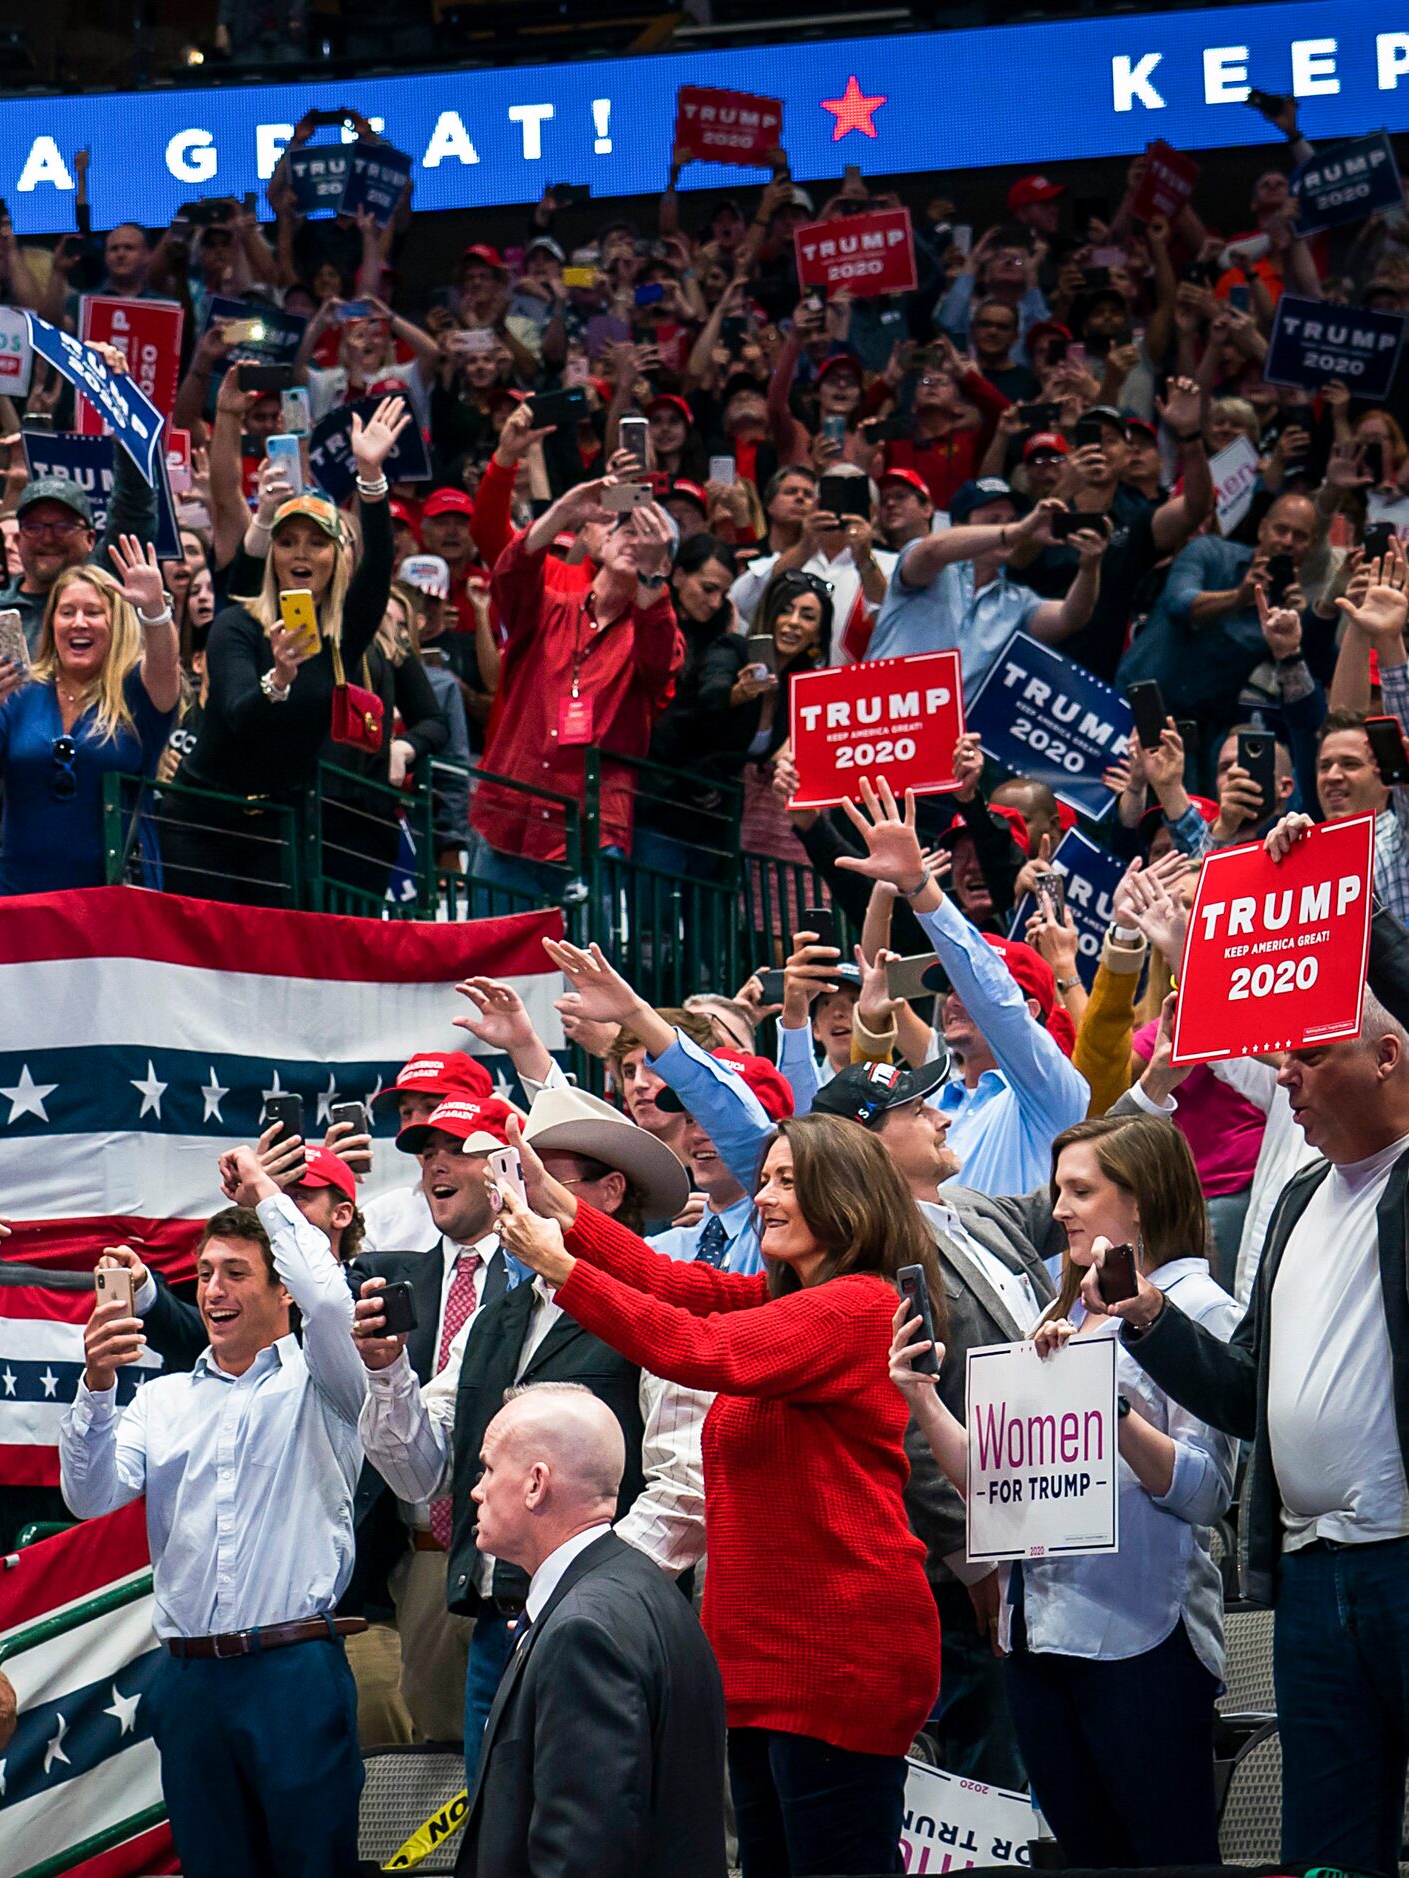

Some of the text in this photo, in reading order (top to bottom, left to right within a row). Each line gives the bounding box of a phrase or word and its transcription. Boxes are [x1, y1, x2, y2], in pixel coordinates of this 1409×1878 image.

[1112, 32, 1409, 112] KEEP
[683, 105, 778, 128] TRUMP
[702, 131, 755, 149] 2020
[293, 158, 346, 178] TRU
[354, 158, 407, 187] TRUM
[316, 182, 343, 196] 20
[1317, 183, 1370, 210] 2020
[801, 229, 906, 262] TRUMP
[827, 260, 885, 282] 2020
[1283, 316, 1397, 351] TRUMP
[139, 344, 159, 398] 020
[1302, 351, 1365, 376] 2020
[33, 461, 115, 492] TRUM
[799, 687, 951, 732] TRUMP
[826, 721, 924, 743] KEEP AMERICA GREAT!
[1037, 715, 1073, 741] AMERICA
[835, 738, 916, 770] 2020
[1009, 718, 1086, 774] 2020
[1051, 859, 1115, 922] TRU
[1201, 874, 1361, 941] TRUMP
[1224, 930, 1330, 960] KEEP AMERICA GREAT!
[1228, 956, 1319, 1001] 2020
[975, 1401, 1103, 1471] Women
[989, 1472, 1091, 1504] FOR TRUMP
[959, 1779, 990, 1795] 2020
[428, 1796, 470, 1845] NO
[903, 1810, 978, 1852] TRU
[991, 1837, 1031, 1866] OR
